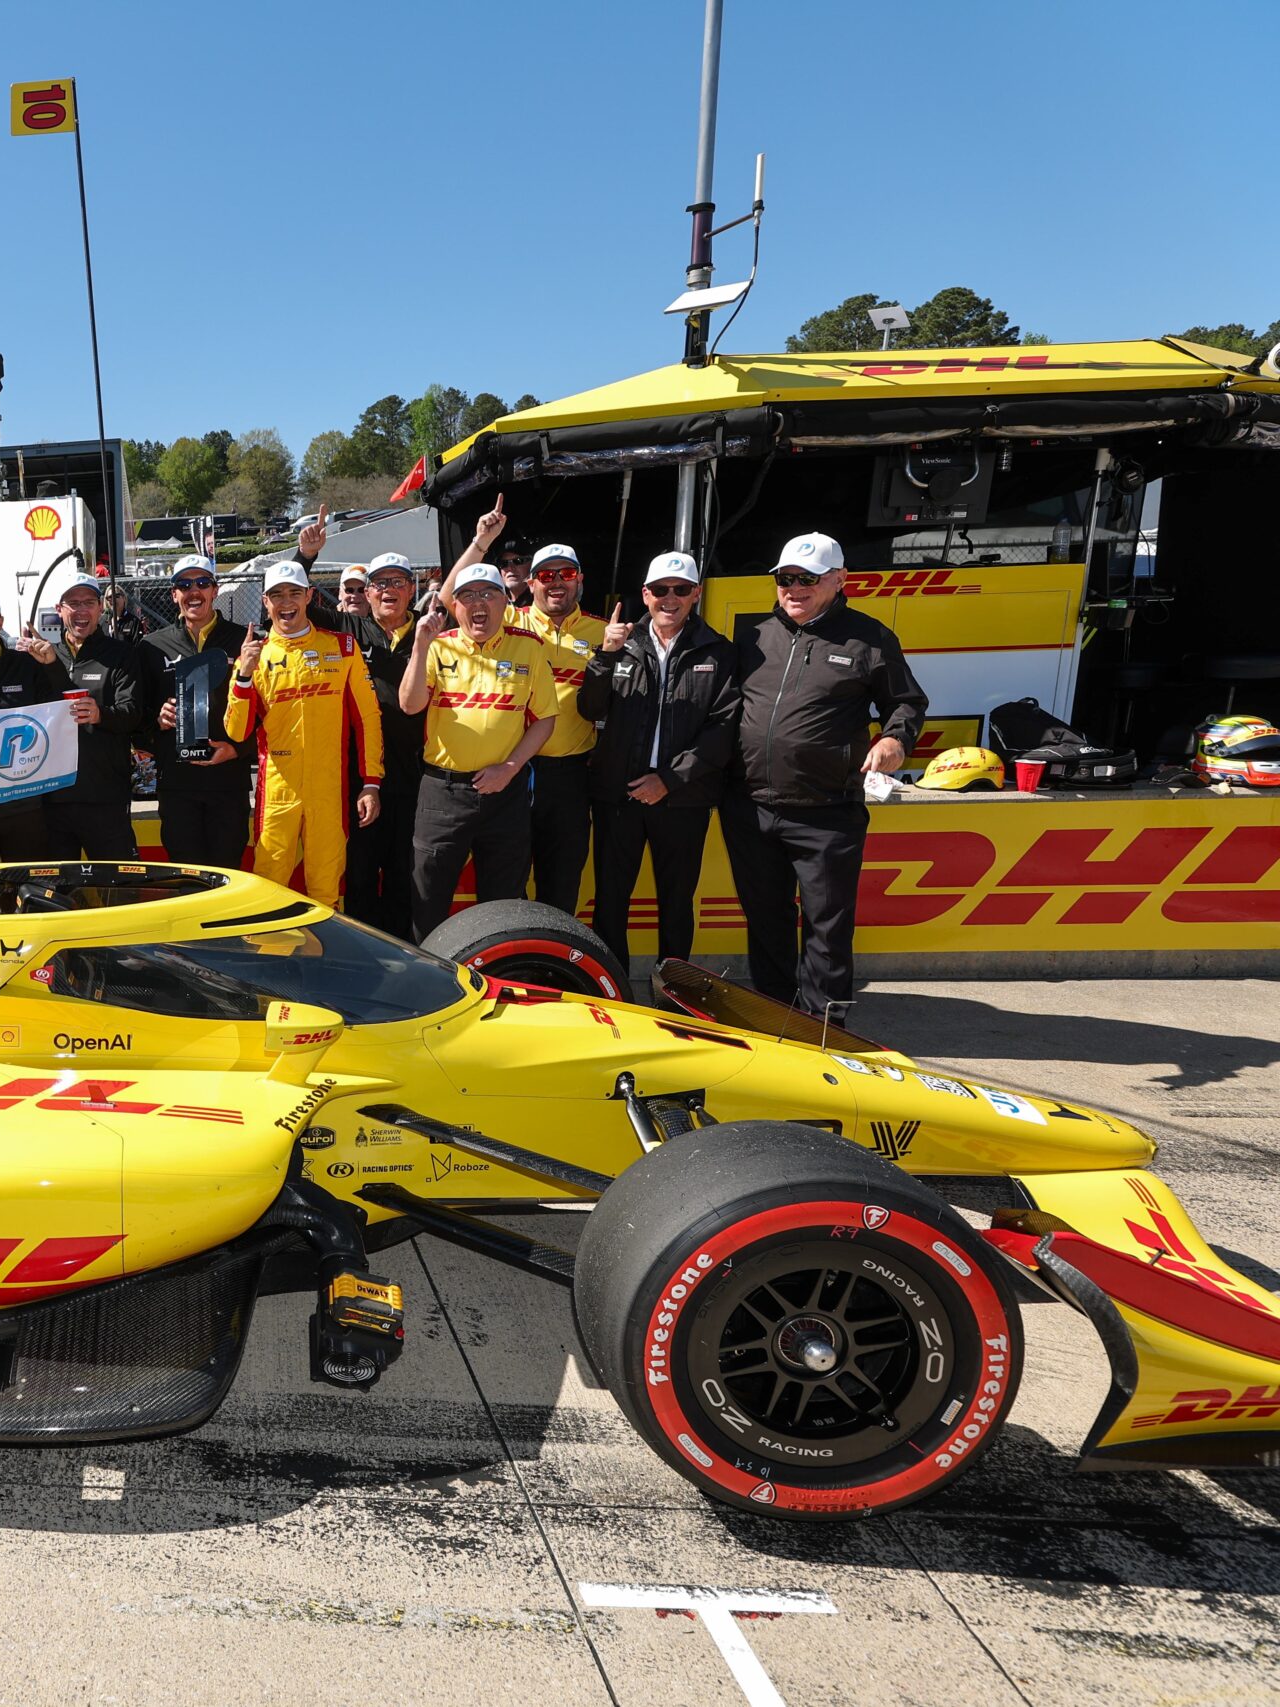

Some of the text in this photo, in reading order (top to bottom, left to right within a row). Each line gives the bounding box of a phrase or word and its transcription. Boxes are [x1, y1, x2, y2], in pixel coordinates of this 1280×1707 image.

[22, 84, 66, 129] 10
[850, 356, 1079, 376] DHL
[921, 457, 952, 465] ViewSonic
[842, 570, 960, 598] DHL
[273, 682, 333, 704] DHL
[437, 692, 523, 712] DHL
[27, 755, 41, 763] NTT
[189, 749, 207, 757] NTT
[934, 761, 971, 774] DHL
[2, 783, 44, 798] MOTORSPORTS
[33, 868, 56, 876] DHL
[122, 865, 146, 873] DHL
[183, 866, 199, 874] DHL
[53, 1033, 132, 1053] OpenAI
[293, 1029, 334, 1045] DHL
[274, 1077, 338, 1134] Firestone
[300, 1133, 333, 1144] eurol
[370, 1128, 401, 1136] SHERWIN
[362, 1164, 415, 1173] RACING OPTICS
[453, 1163, 490, 1173] Roboze
[933, 1242, 969, 1275] ENLITEN
[862, 1259, 926, 1308] RACING
[648, 1253, 714, 1386] Firestone
[934, 1333, 1008, 1468] Firestone
[757, 1436, 835, 1458] RACING
